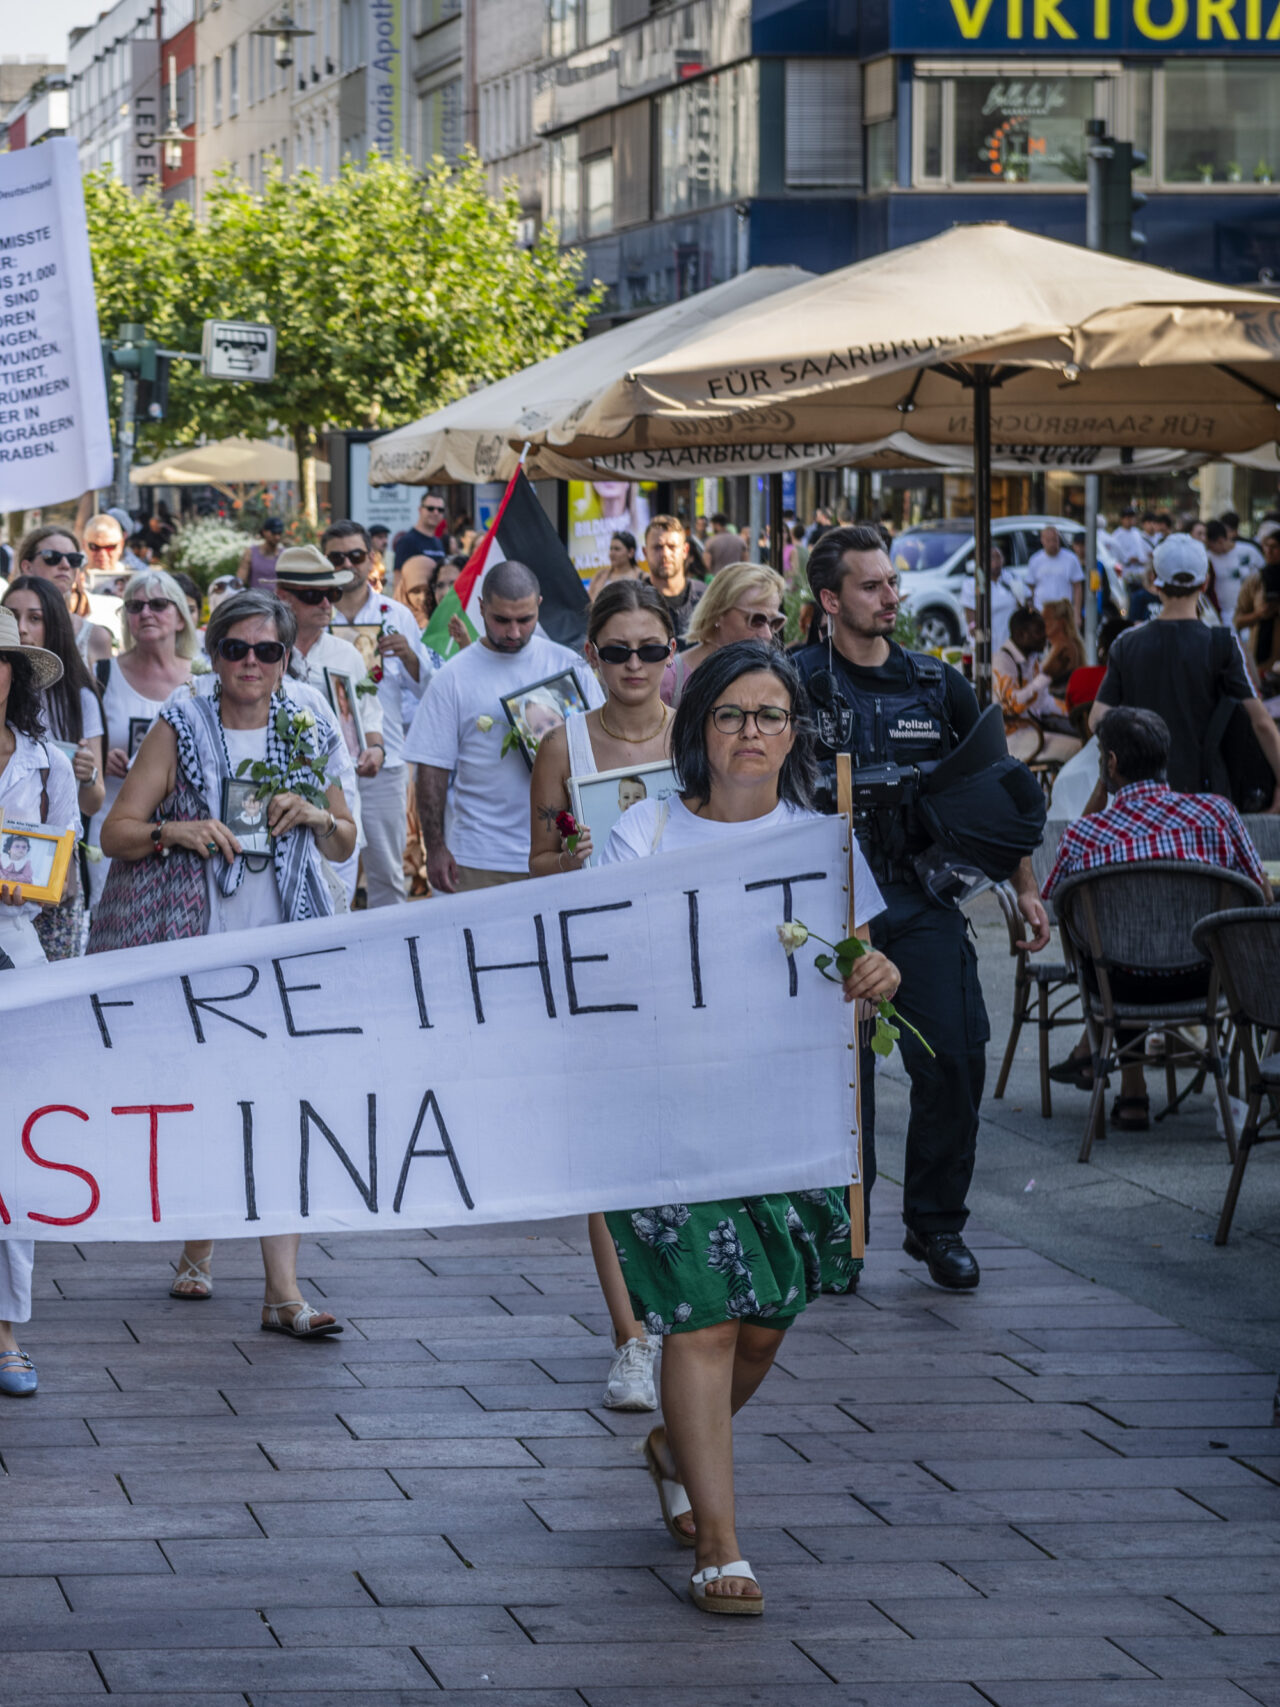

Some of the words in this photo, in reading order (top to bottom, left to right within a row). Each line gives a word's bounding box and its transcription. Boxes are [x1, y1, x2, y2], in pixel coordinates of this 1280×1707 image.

[16, 263, 57, 286] 21.000
[4, 289, 40, 308] SIND
[707, 368, 772, 400] FÜR
[24, 405, 41, 421] IN
[888, 729, 941, 739] Videodokumentation
[897, 719, 933, 730] Polizei
[90, 872, 827, 1049] FREIHEIT
